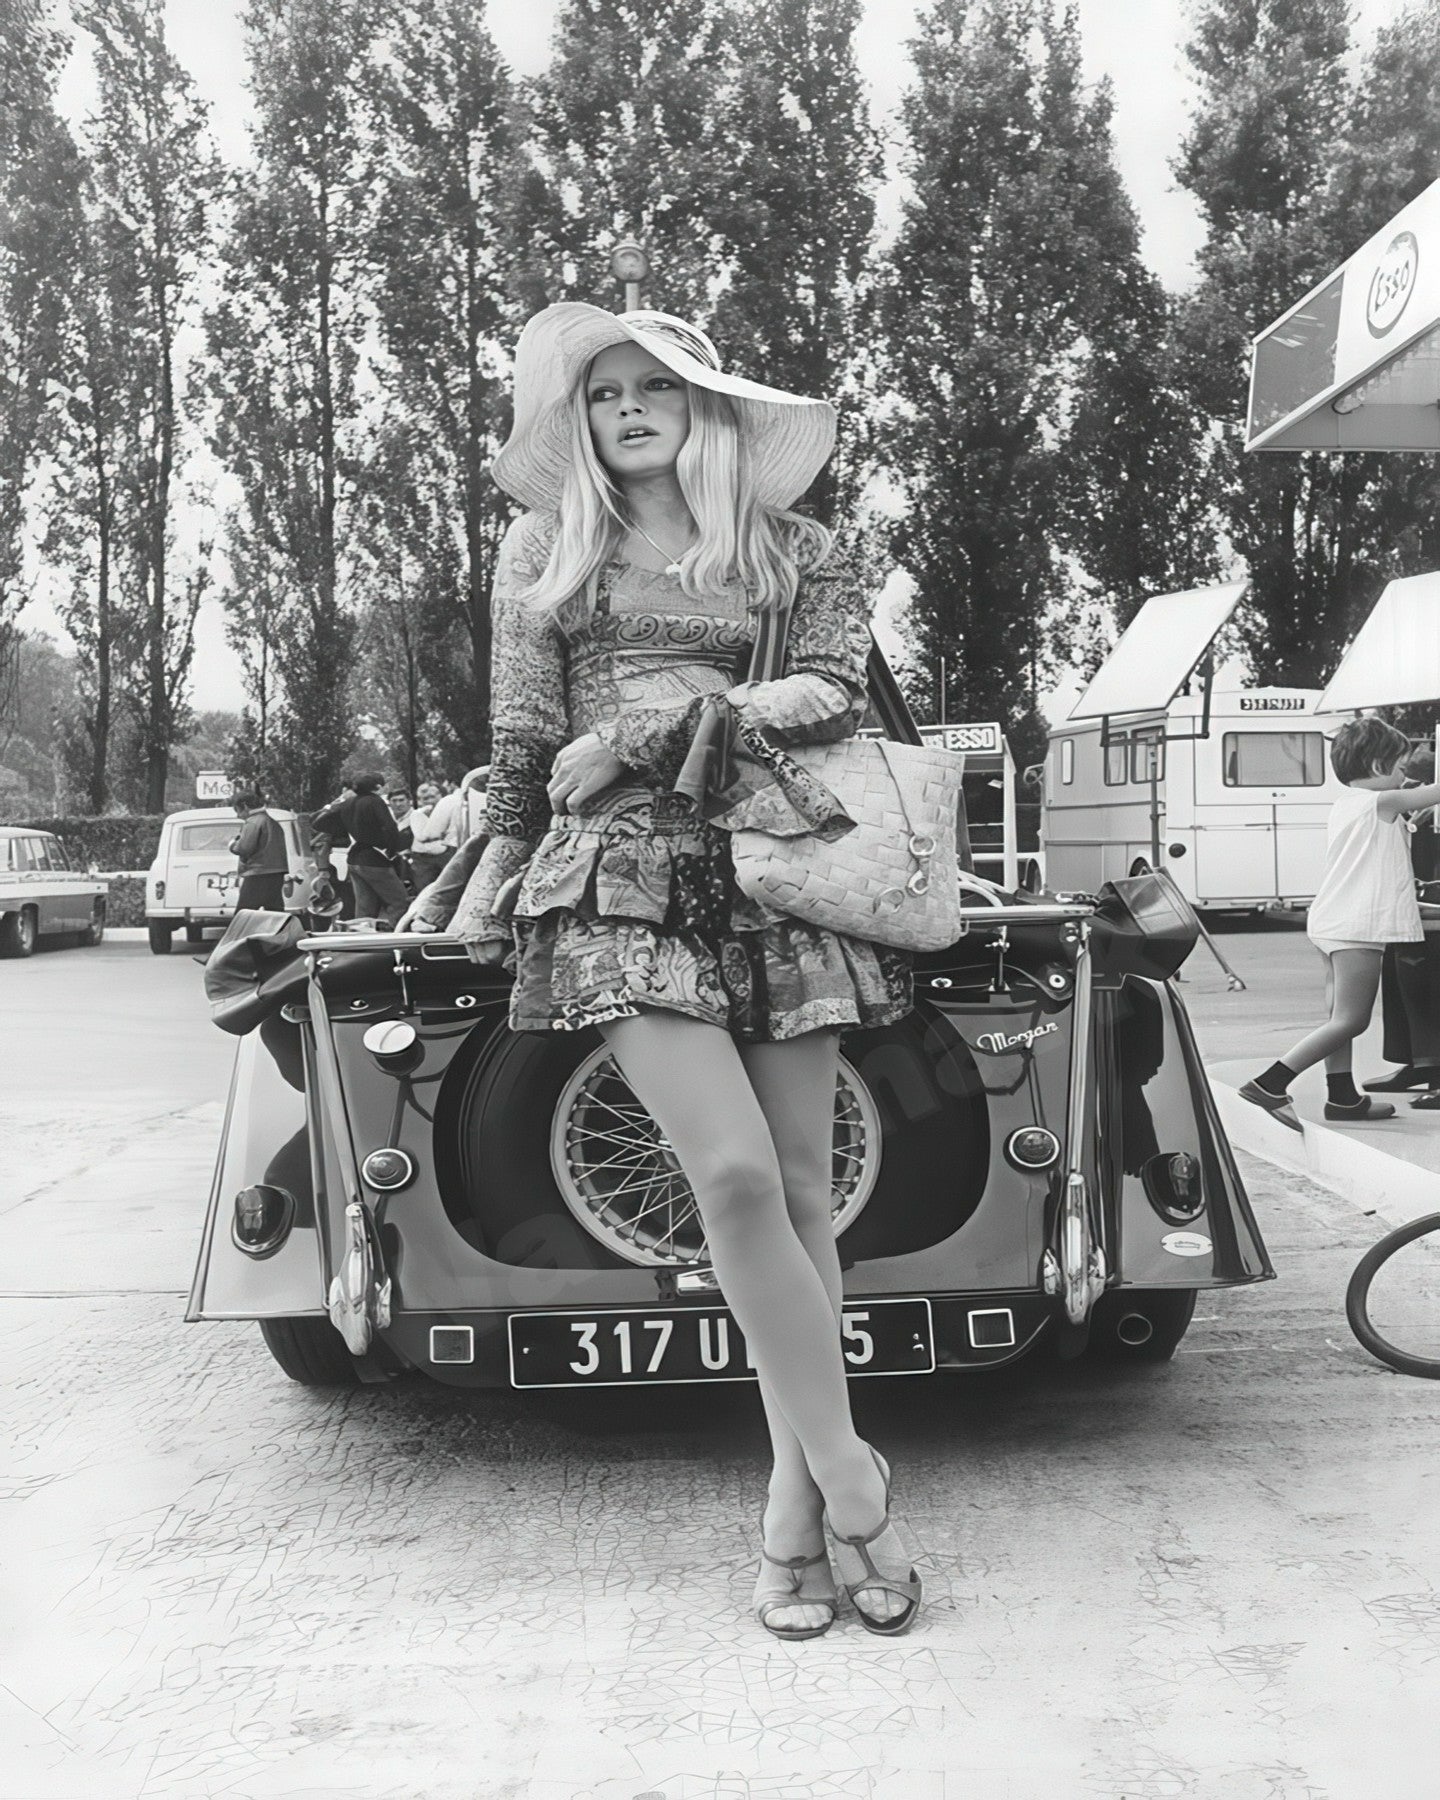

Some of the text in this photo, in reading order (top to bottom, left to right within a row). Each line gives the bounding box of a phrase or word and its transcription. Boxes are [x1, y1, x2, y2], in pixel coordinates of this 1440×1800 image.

[946, 727, 995, 749] ESSO
[976, 1022, 1059, 1053] Morgan
[569, 1320, 673, 1375] 317
